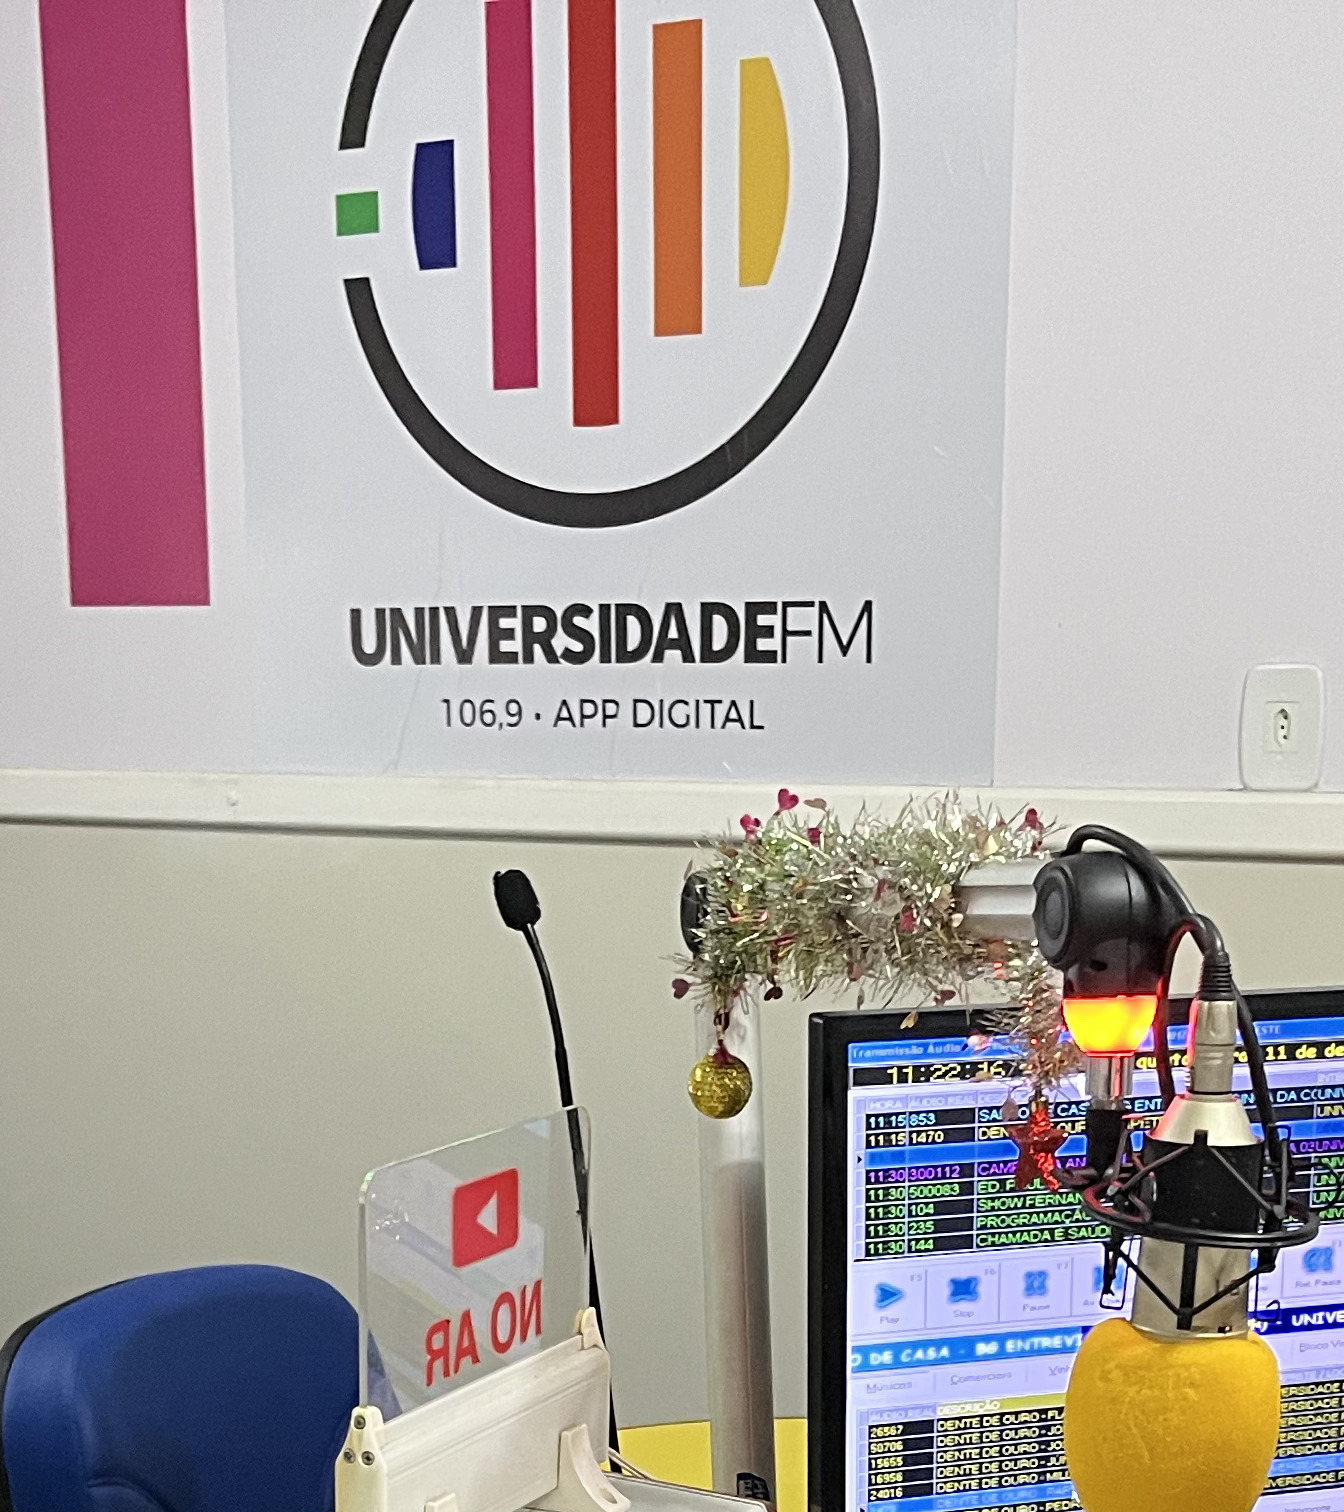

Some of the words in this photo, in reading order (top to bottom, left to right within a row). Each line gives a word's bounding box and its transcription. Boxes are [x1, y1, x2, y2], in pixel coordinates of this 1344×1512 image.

[350, 600, 874, 666] UNIVERSIDADEFM
[441, 699, 523, 730] 106,9
[553, 699, 619, 728] APP
[632, 699, 764, 730] DIGITAL
[1265, 1044, 1286, 1060] 11
[1295, 1045, 1316, 1058] de
[886, 1061, 1005, 1084] 11:22:16
[869, 1116, 906, 1128] 11:15
[909, 1114, 936, 1125] 853
[869, 1134, 906, 1146] 11:15
[911, 1131, 944, 1143] 1470
[868, 1170, 906, 1182] 11:30
[907, 1166, 960, 1180] 300112
[868, 1188, 906, 1200] 11:30
[868, 1206, 906, 1218] 11:30
[909, 1204, 934, 1216] 104
[978, 1197, 1024, 1210] SHOW
[868, 1223, 906, 1236] 11:30
[909, 1222, 934, 1233] 235
[868, 1241, 906, 1254] 11:30
[910, 1240, 934, 1251] 144
[977, 1230, 1050, 1247] CHAMADA
[870, 1351, 893, 1364] DE
[901, 1346, 949, 1362] CASA
[1006, 1334, 1084, 1352] ENTREVI
[937, 1416, 980, 1431] DENTE
[983, 1415, 1000, 1426] DE
[1003, 1412, 1039, 1424] OURO
[937, 1432, 980, 1446] DENTE
[983, 1430, 1000, 1442] DE
[1003, 1427, 1039, 1439] OURO
